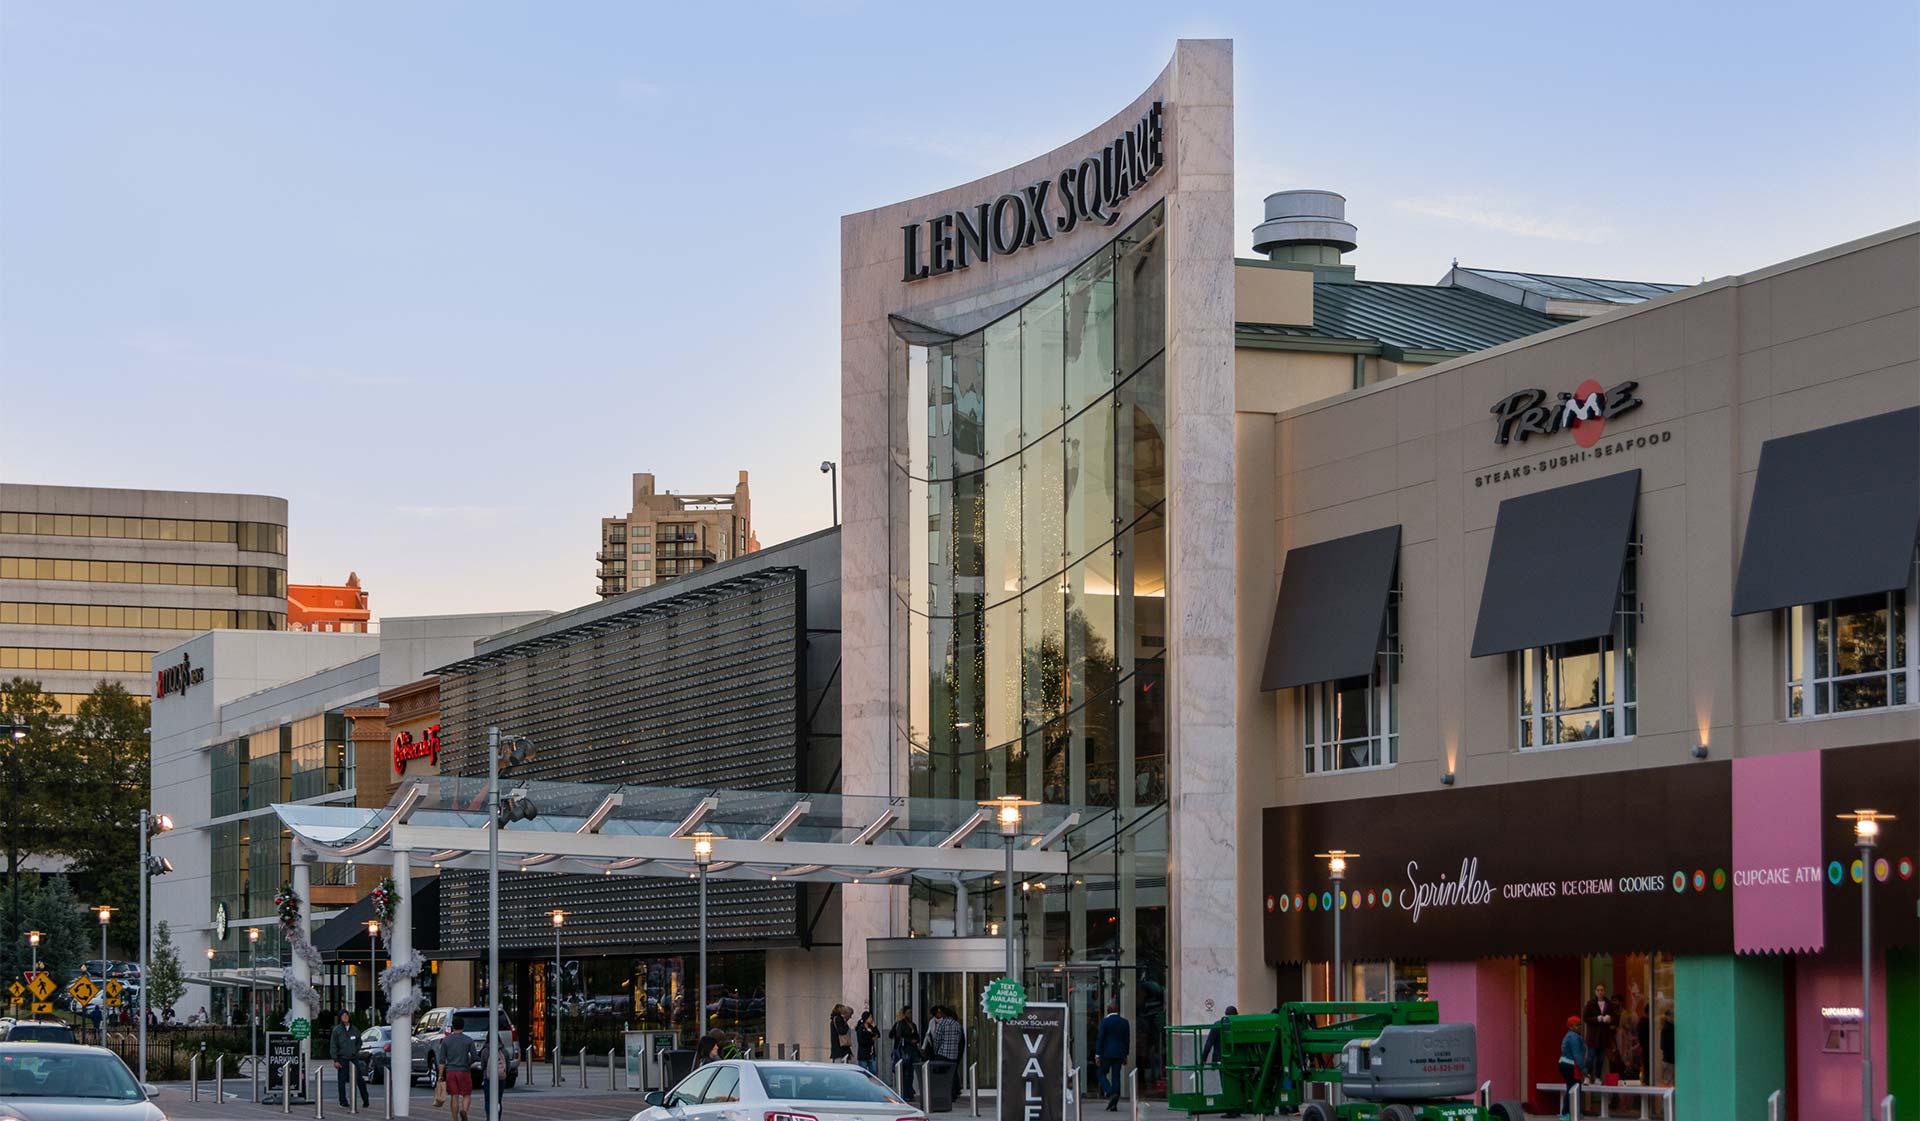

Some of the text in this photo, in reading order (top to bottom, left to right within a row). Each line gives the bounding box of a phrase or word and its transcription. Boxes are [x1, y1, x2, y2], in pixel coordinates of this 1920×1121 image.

[901, 101, 1163, 282] LENOX SQUARE
[1733, 866, 1821, 886] CUPCAKE ATM
[1400, 856, 1497, 923] Sprinkles
[1503, 881, 1556, 899] CUPCAKES
[1619, 875, 1664, 893] COOKIES
[996, 989, 1017, 997] AHEAD
[990, 995, 1022, 1004] AVAILABLE
[274, 1047, 295, 1055] VALET
[270, 1055, 299, 1065] PARKING
[1457, 1107, 1478, 1116] BOOM
